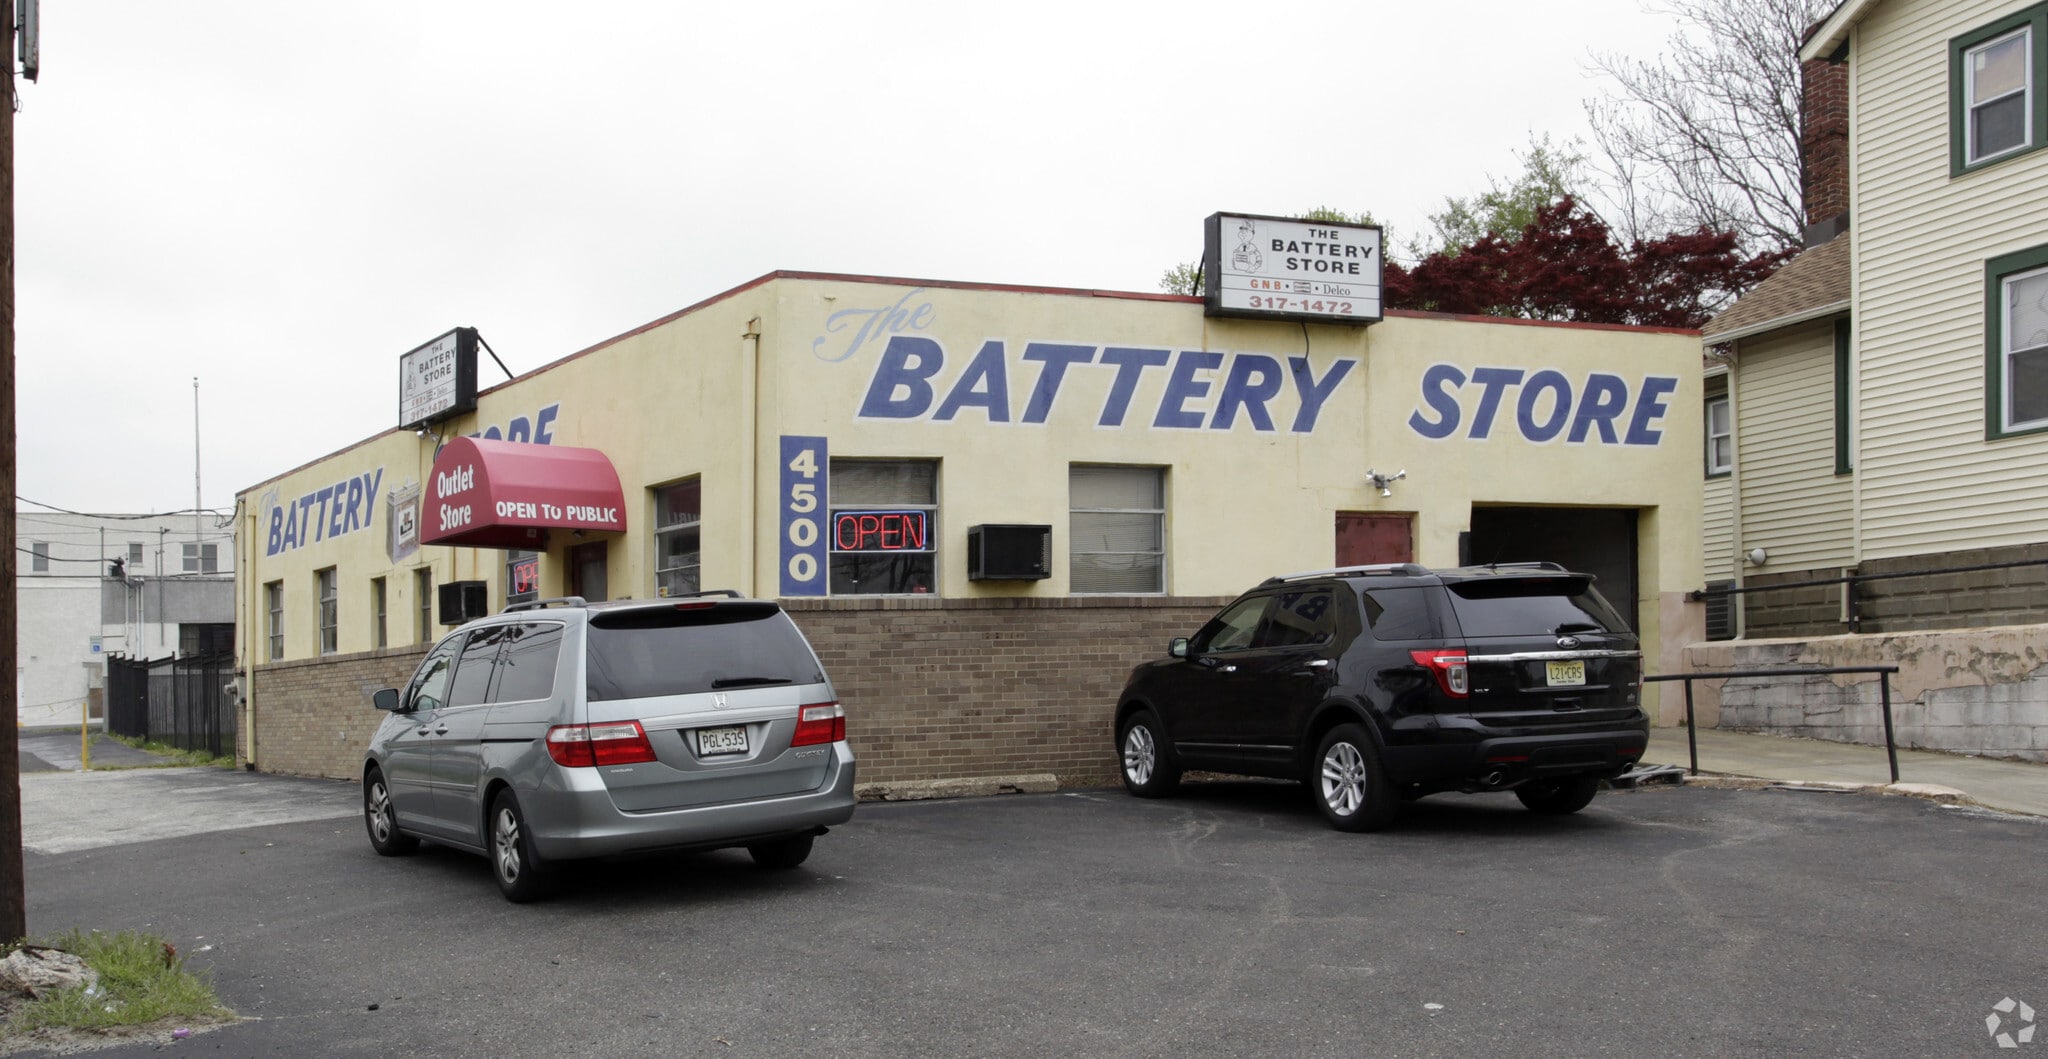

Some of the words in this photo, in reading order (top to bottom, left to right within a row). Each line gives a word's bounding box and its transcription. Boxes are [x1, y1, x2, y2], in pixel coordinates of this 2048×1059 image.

[1309, 228, 1339, 240] THE
[1271, 238, 1374, 259] BATTERY
[1286, 257, 1360, 275] STORE
[1323, 284, 1351, 296] Delco
[1249, 295, 1353, 314] 317-1472
[812, 287, 936, 363] The
[419, 347, 456, 374] BATTERY
[431, 342, 443, 355] THE
[424, 363, 452, 385] STORE
[857, 335, 1357, 433] BATTERY
[410, 398, 448, 422] 317-1472
[1408, 363, 1678, 446] STORE
[437, 464, 474, 499] Outlet
[266, 467, 384, 557] BATTERY
[439, 503, 472, 532] Store
[496, 500, 537, 519] OPEN
[541, 503, 562, 520] TO
[566, 505, 618, 523] PUBLIC
[788, 449, 819, 582] 4500
[837, 514, 923, 550] OPEN
[516, 562, 539, 592] OPE
